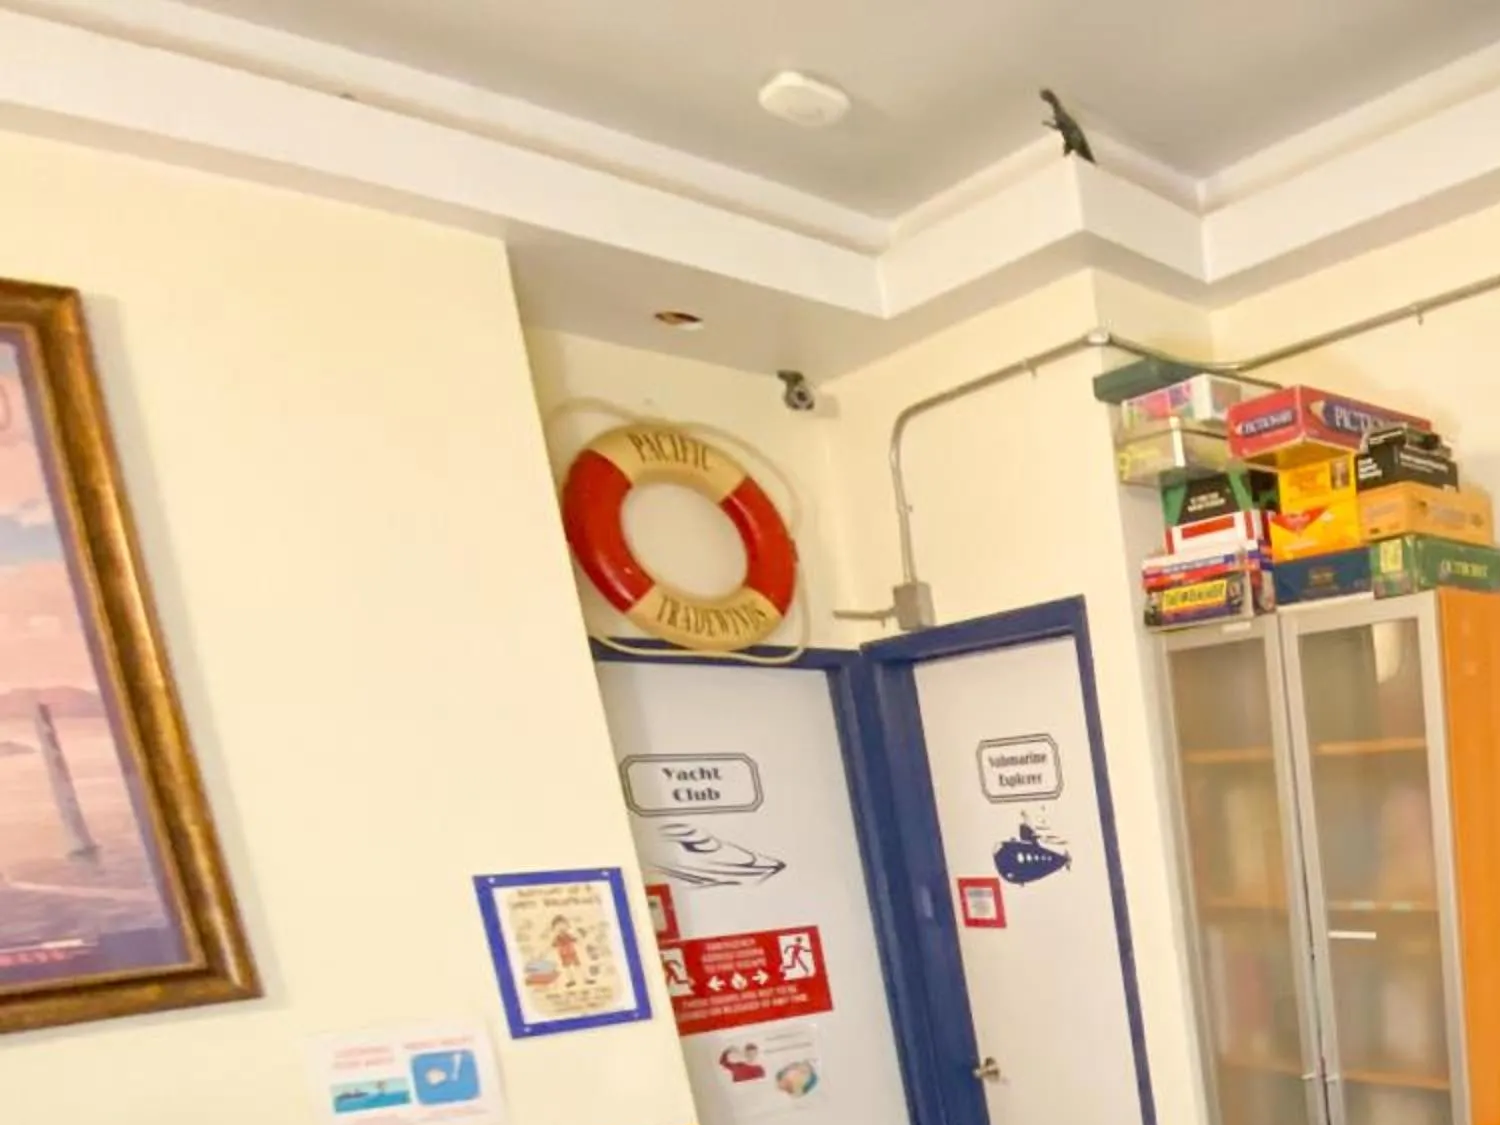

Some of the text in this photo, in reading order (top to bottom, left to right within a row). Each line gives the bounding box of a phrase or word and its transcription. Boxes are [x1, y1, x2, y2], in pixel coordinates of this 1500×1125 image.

[626, 430, 714, 473] PACIFIC
[661, 766, 722, 782] Yacht
[998, 772, 1043, 788] Explorer
[672, 787, 721, 802] Club
